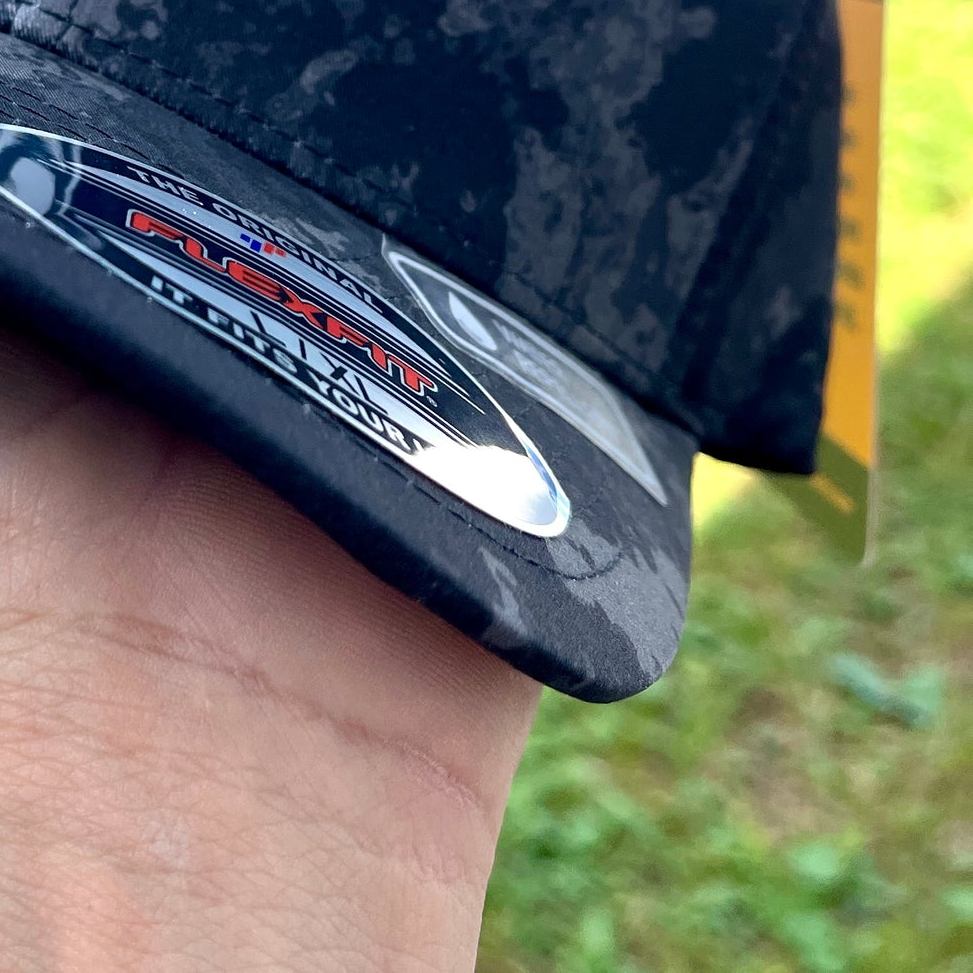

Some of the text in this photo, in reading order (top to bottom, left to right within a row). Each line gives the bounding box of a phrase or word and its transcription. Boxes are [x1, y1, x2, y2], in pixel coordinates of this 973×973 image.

[127, 165, 383, 314] THE ORIGINAL
[150, 275, 413, 456] IT FITS YOUR
